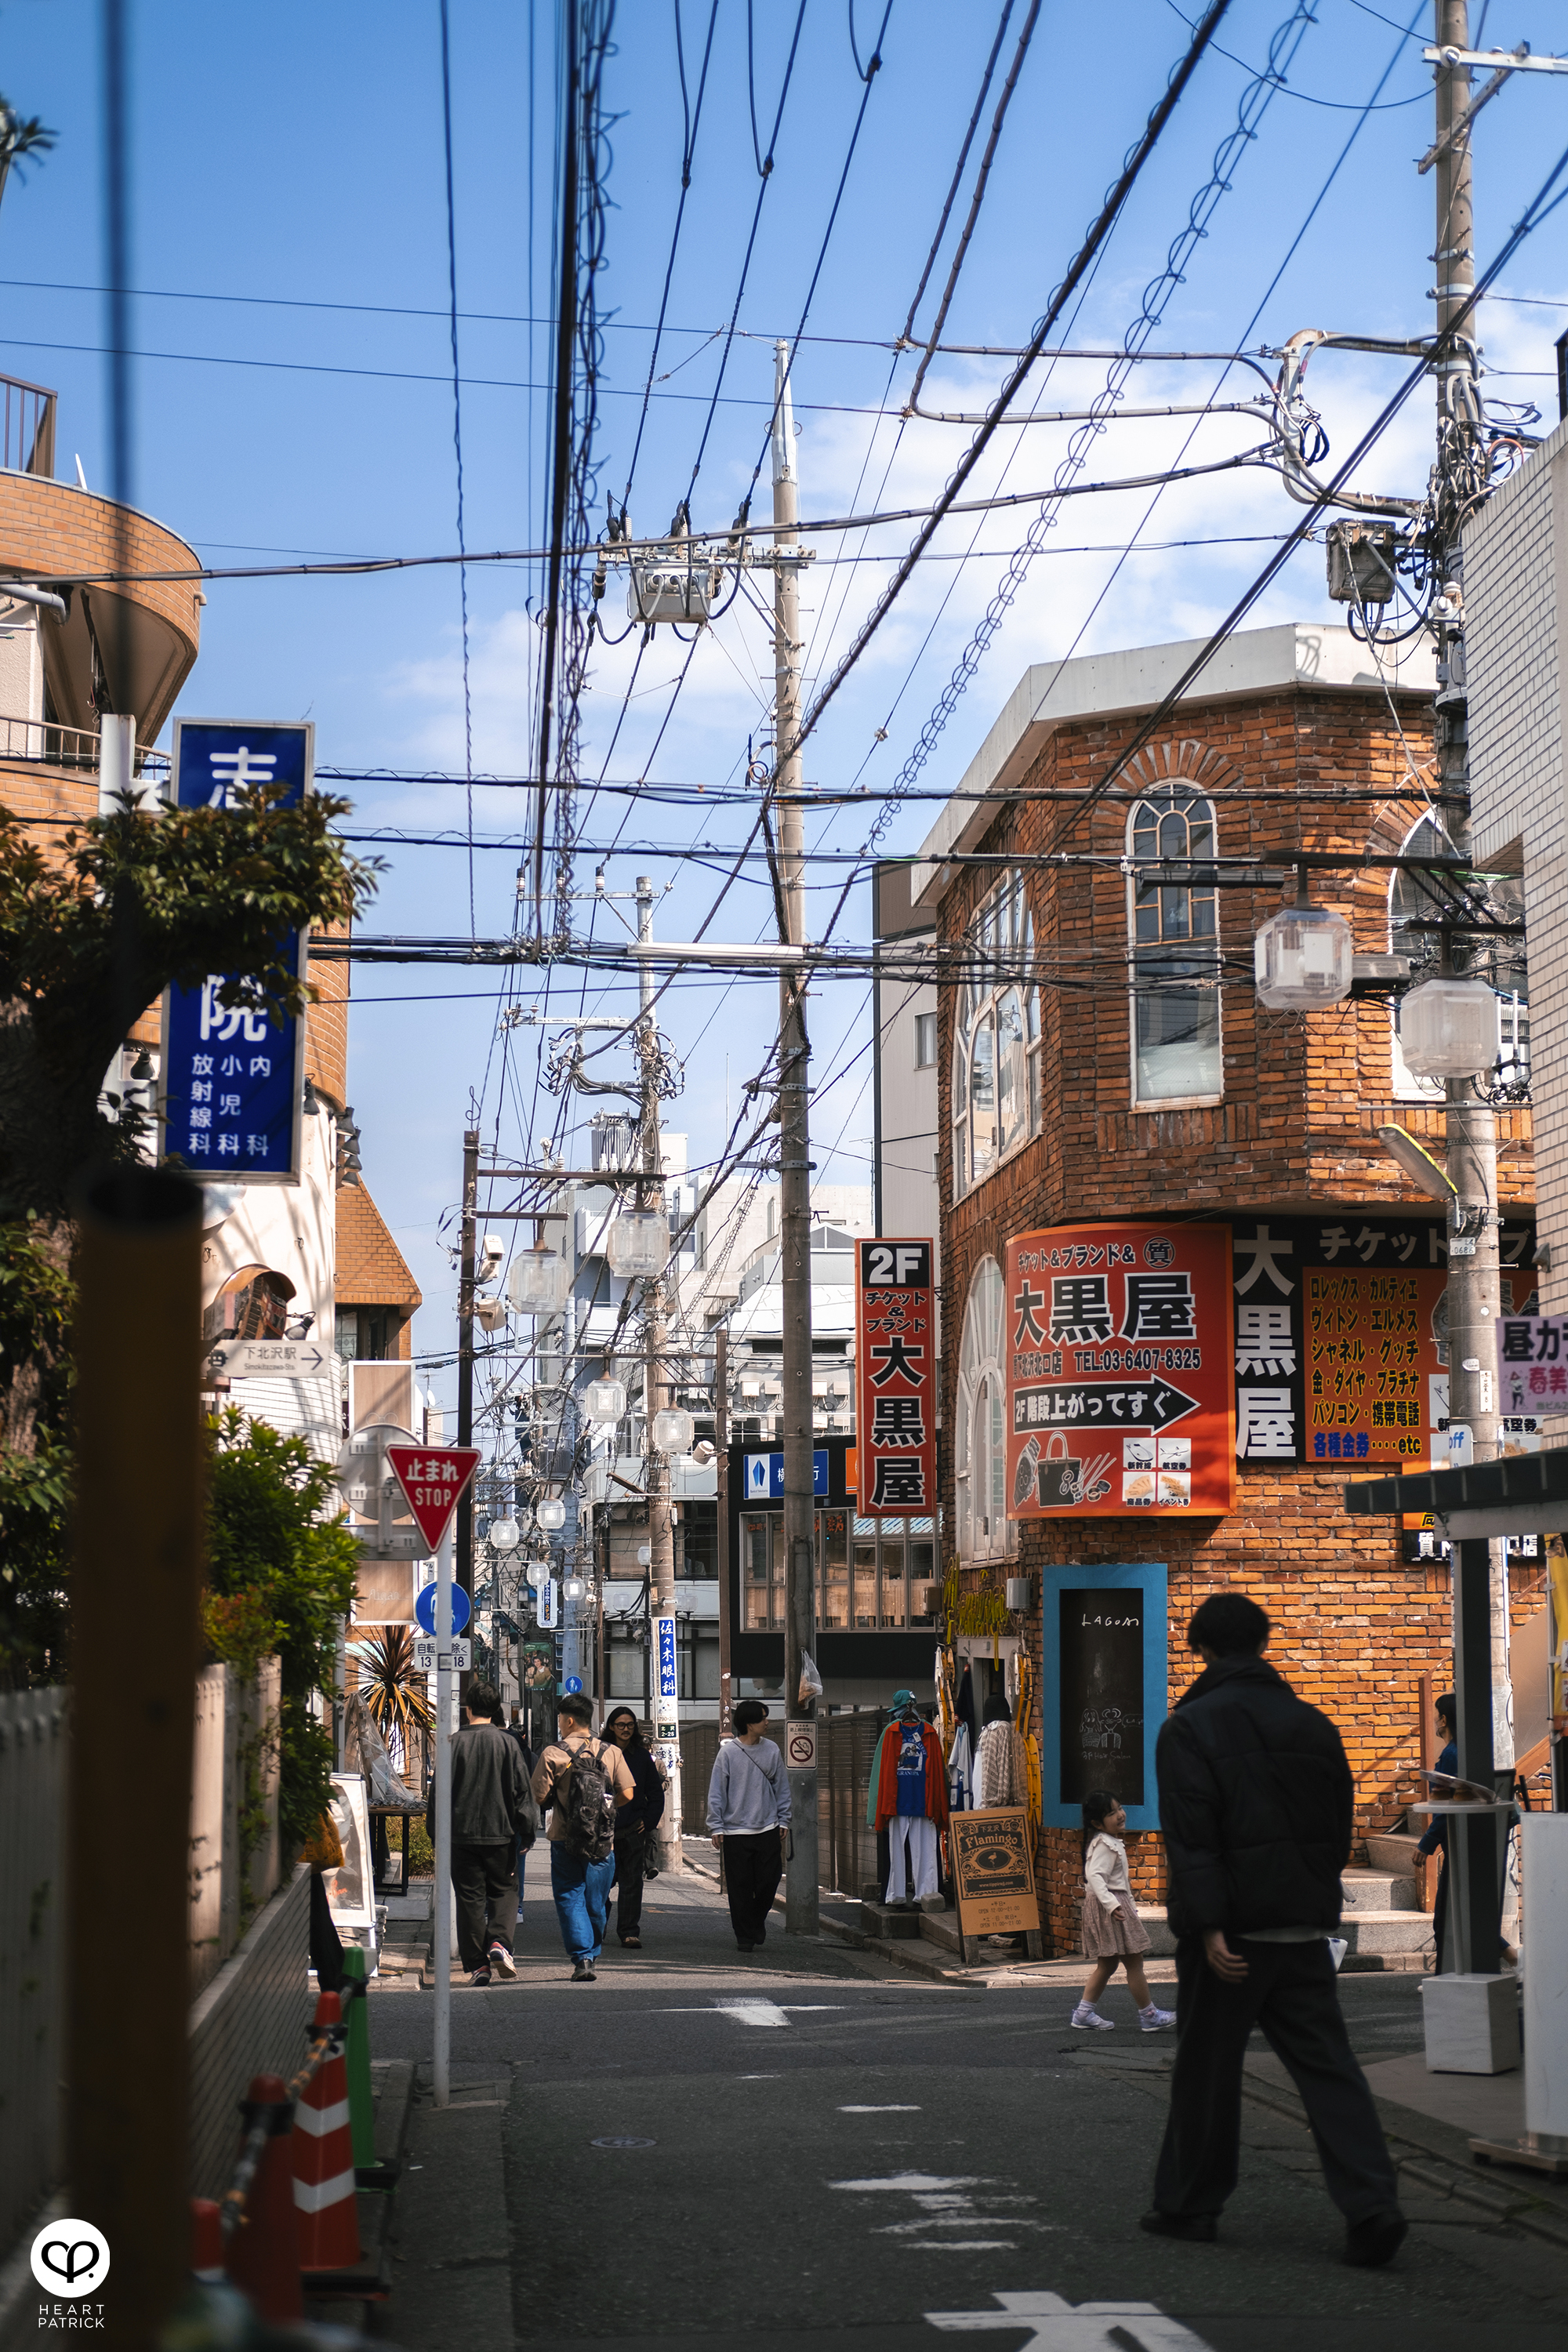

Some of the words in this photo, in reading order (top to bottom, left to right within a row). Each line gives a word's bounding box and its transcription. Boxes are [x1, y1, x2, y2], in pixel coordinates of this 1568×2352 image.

[188, 1053, 214, 1155] 放射線科
[218, 1054, 243, 1156] 小児科
[246, 1054, 271, 1156] 内科
[869, 1247, 923, 1283] 2F
[866, 1290, 927, 1306] チケット
[1310, 1274, 1419, 1304] ロレックス・カルティエ
[866, 1317, 927, 1333] ブランド
[887, 1305, 906, 1317] &
[1014, 1272, 1197, 1350] 大黒屋
[1310, 1304, 1420, 1335] ヴィトン・エルメス
[244, 1347, 296, 1359] 下北沢駅
[1233, 1224, 1297, 1460] 大黒屋
[1311, 1335, 1421, 1367] シャネル・グッチ
[1502, 1320, 1568, 1362] 昼カ
[1074, 1348, 1202, 1373] TEL:03-6407-8325
[1311, 1366, 1421, 1398] 金・ダイヤ・プラチナ
[868, 1334, 927, 1509] 大黒屋
[1027, 1391, 1172, 1422] 階段上がってすぐ
[1312, 1399, 1421, 1428] パソコン・携帯電話
[406, 1458, 459, 1482] 止まれ
[416, 1488, 452, 1507] STOP
[660, 1621, 675, 1695] 佐々木眼科
[965, 1833, 1018, 1849] Flamingo
